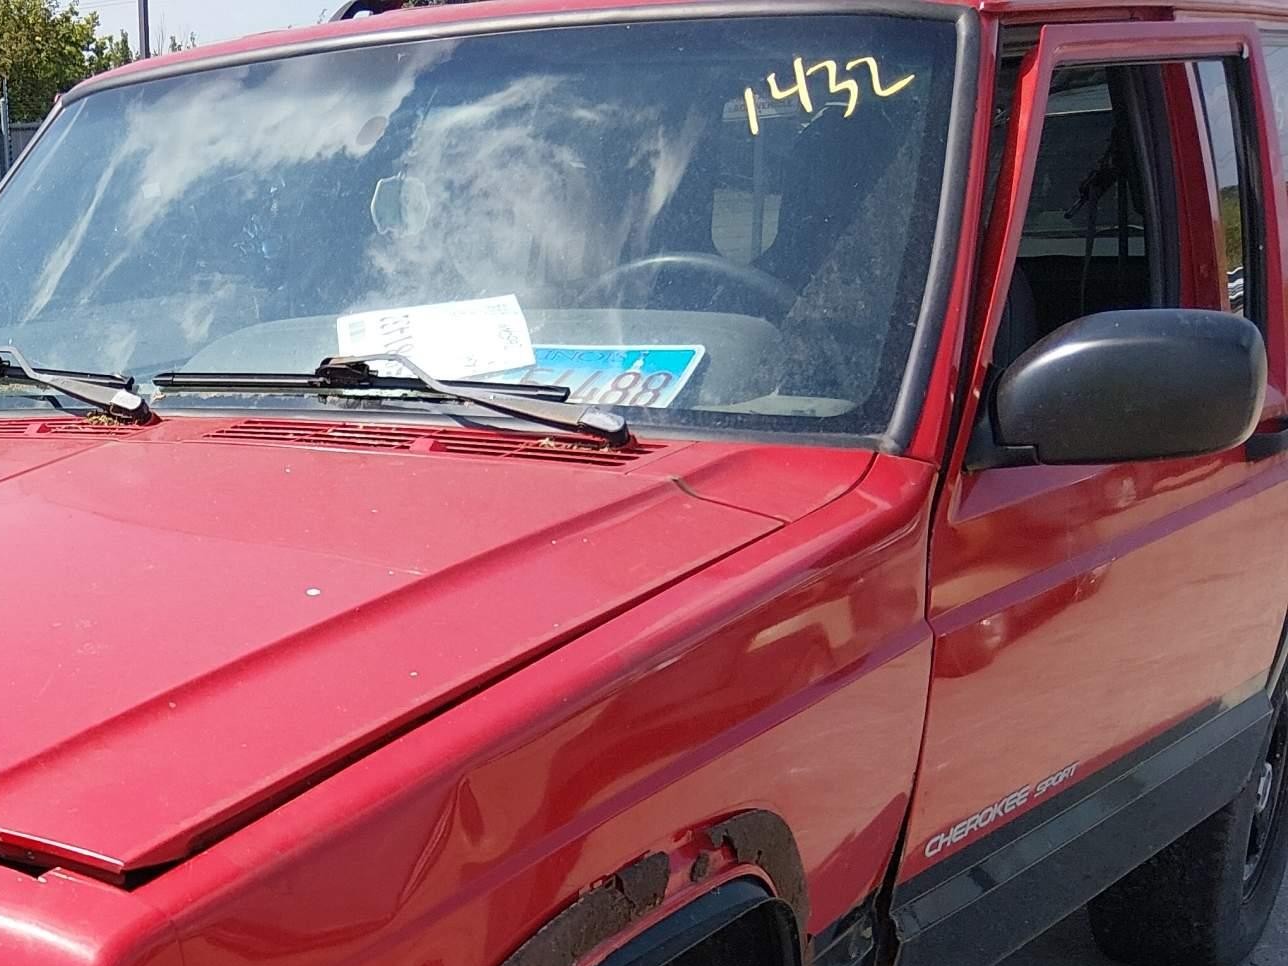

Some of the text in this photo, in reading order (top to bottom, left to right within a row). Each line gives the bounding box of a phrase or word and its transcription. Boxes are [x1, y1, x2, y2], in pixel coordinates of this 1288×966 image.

[744, 57, 915, 135] 1432
[924, 760, 1080, 858] CHEROKEE SPORT
